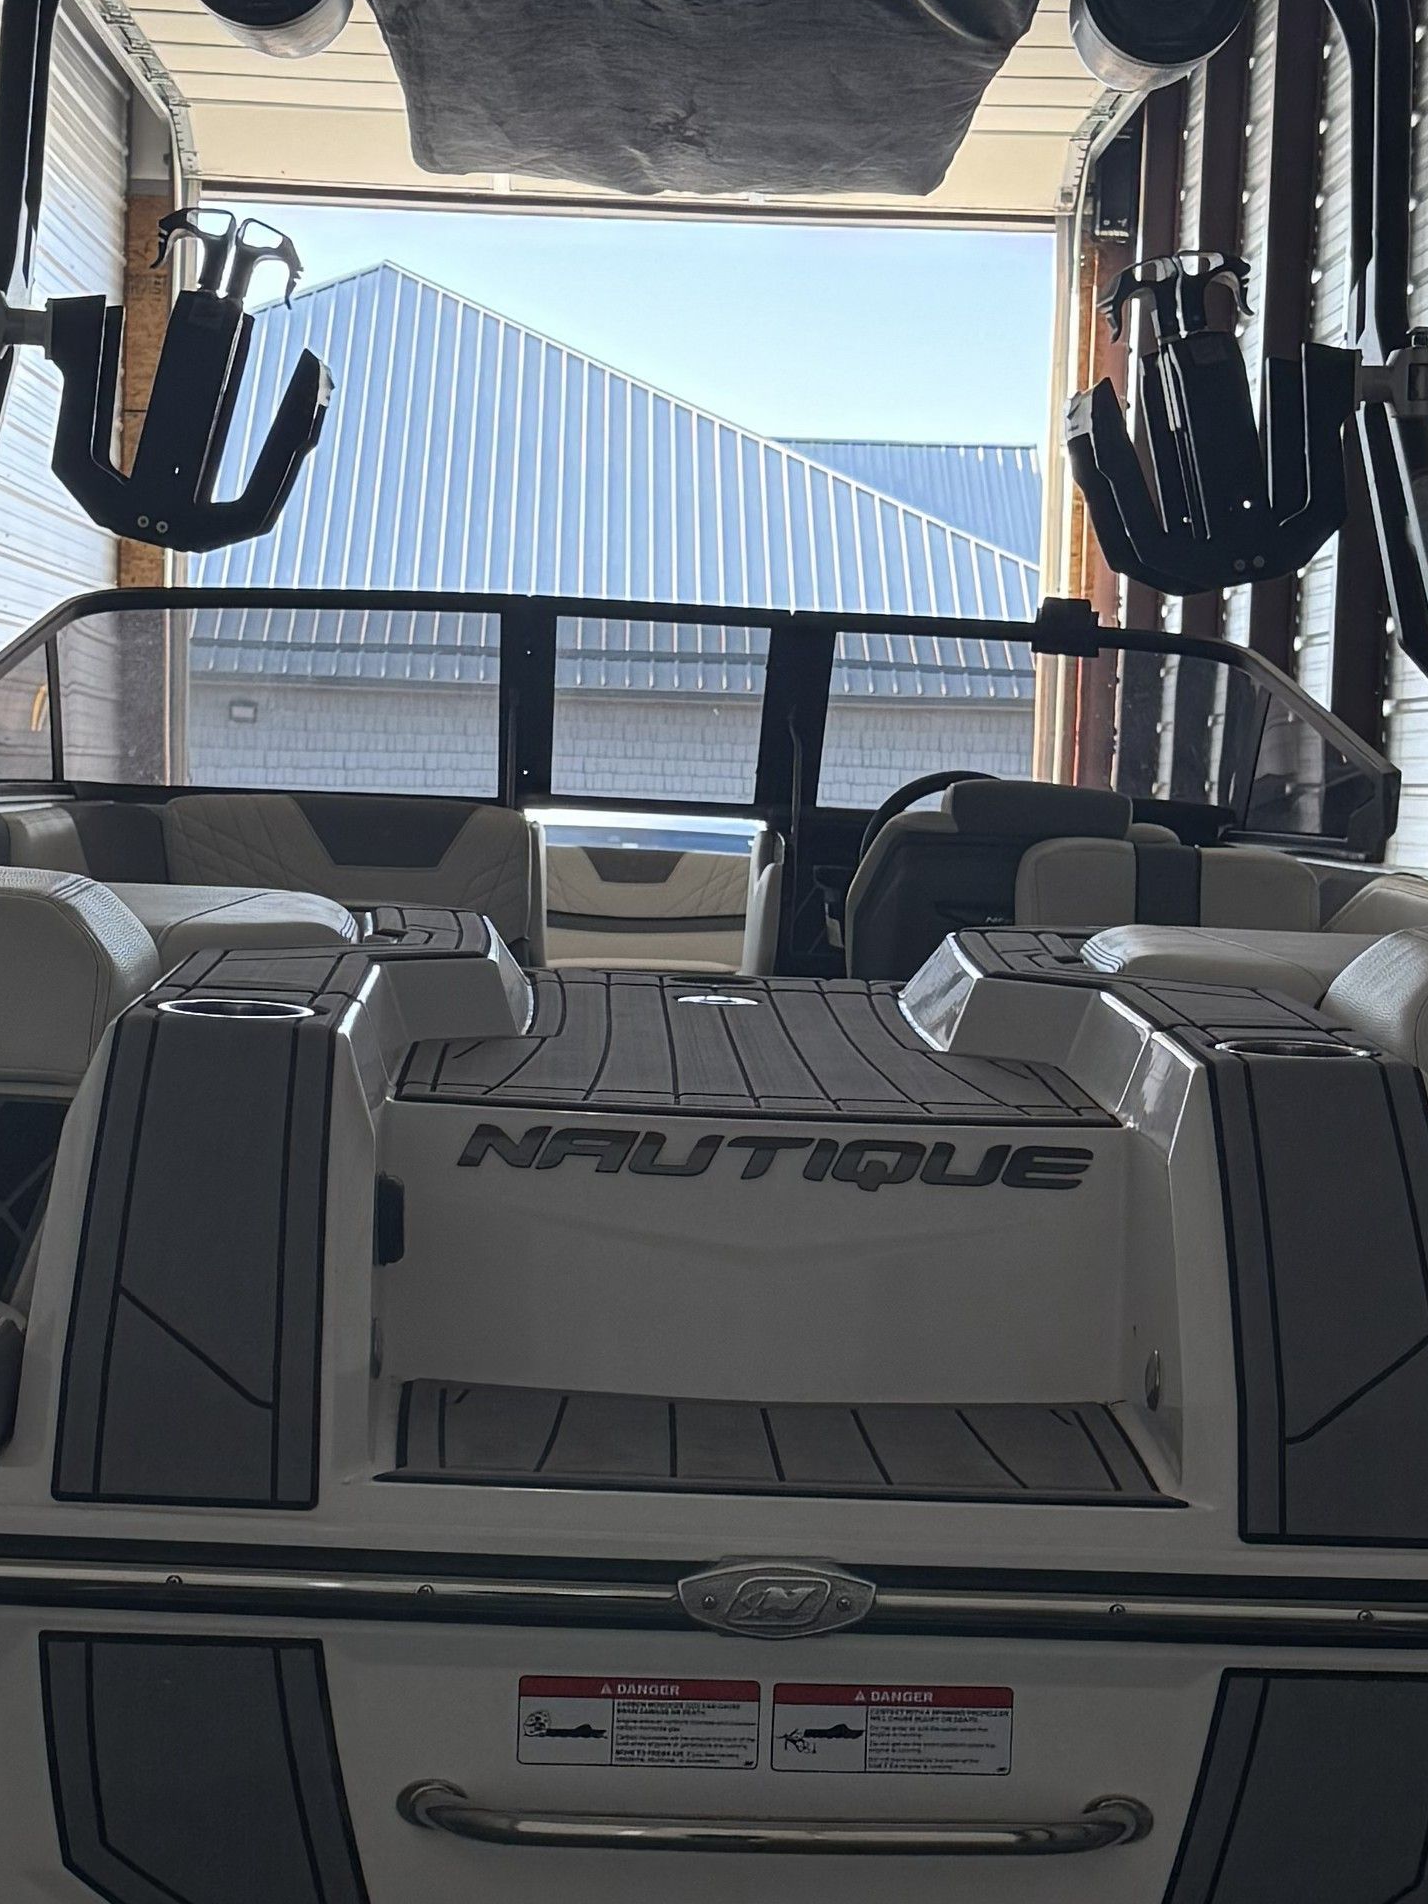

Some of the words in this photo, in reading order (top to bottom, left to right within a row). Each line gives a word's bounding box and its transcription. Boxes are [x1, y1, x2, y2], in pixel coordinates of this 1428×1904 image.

[457, 1123, 1094, 1192] NAUTIQUE
[616, 1683, 680, 1696] DANGER
[870, 1690, 934, 1703] DANGER
